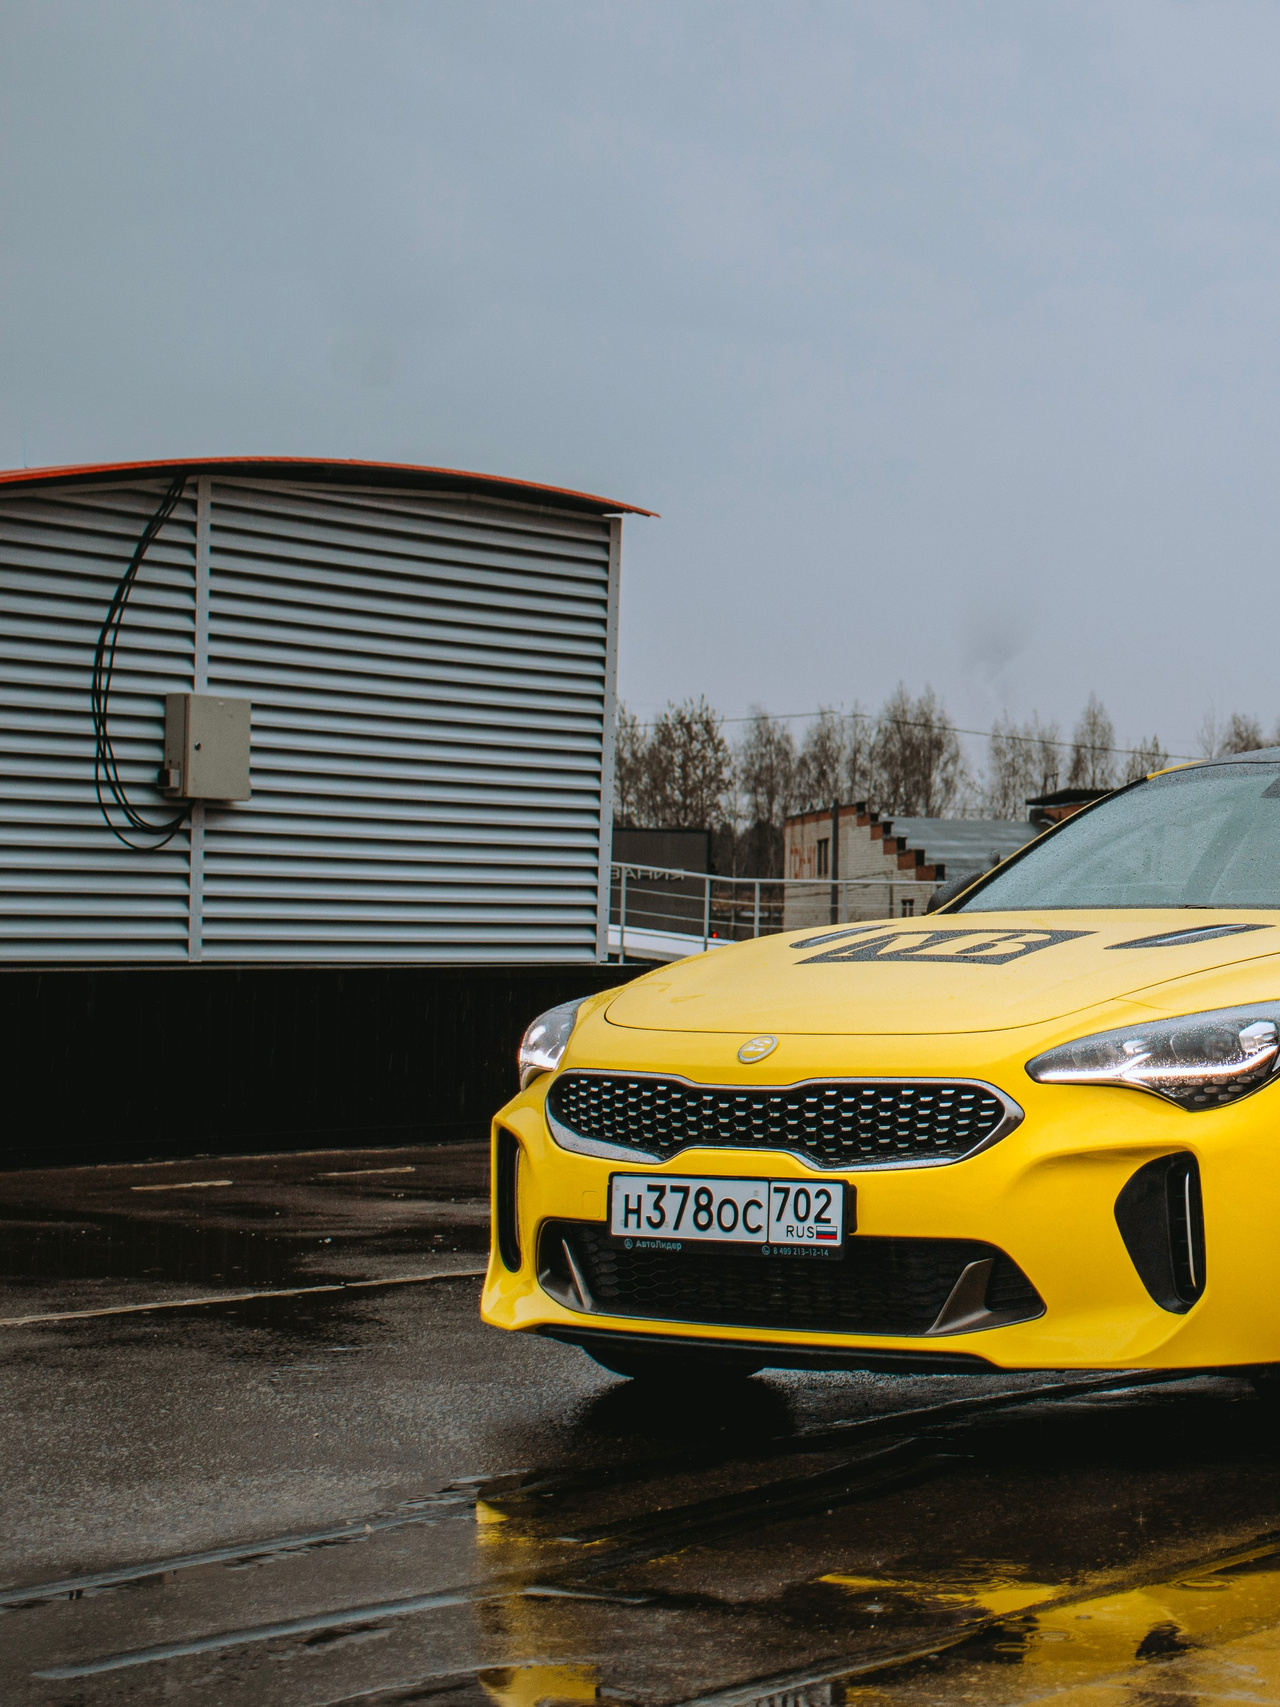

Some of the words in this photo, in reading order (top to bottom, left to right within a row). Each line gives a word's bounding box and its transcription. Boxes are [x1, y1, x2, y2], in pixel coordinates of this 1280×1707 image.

[773, 1186, 833, 1224] 702
[786, 1225, 815, 1239] RUS
[636, 1239, 682, 1251] АвтоЛидер
